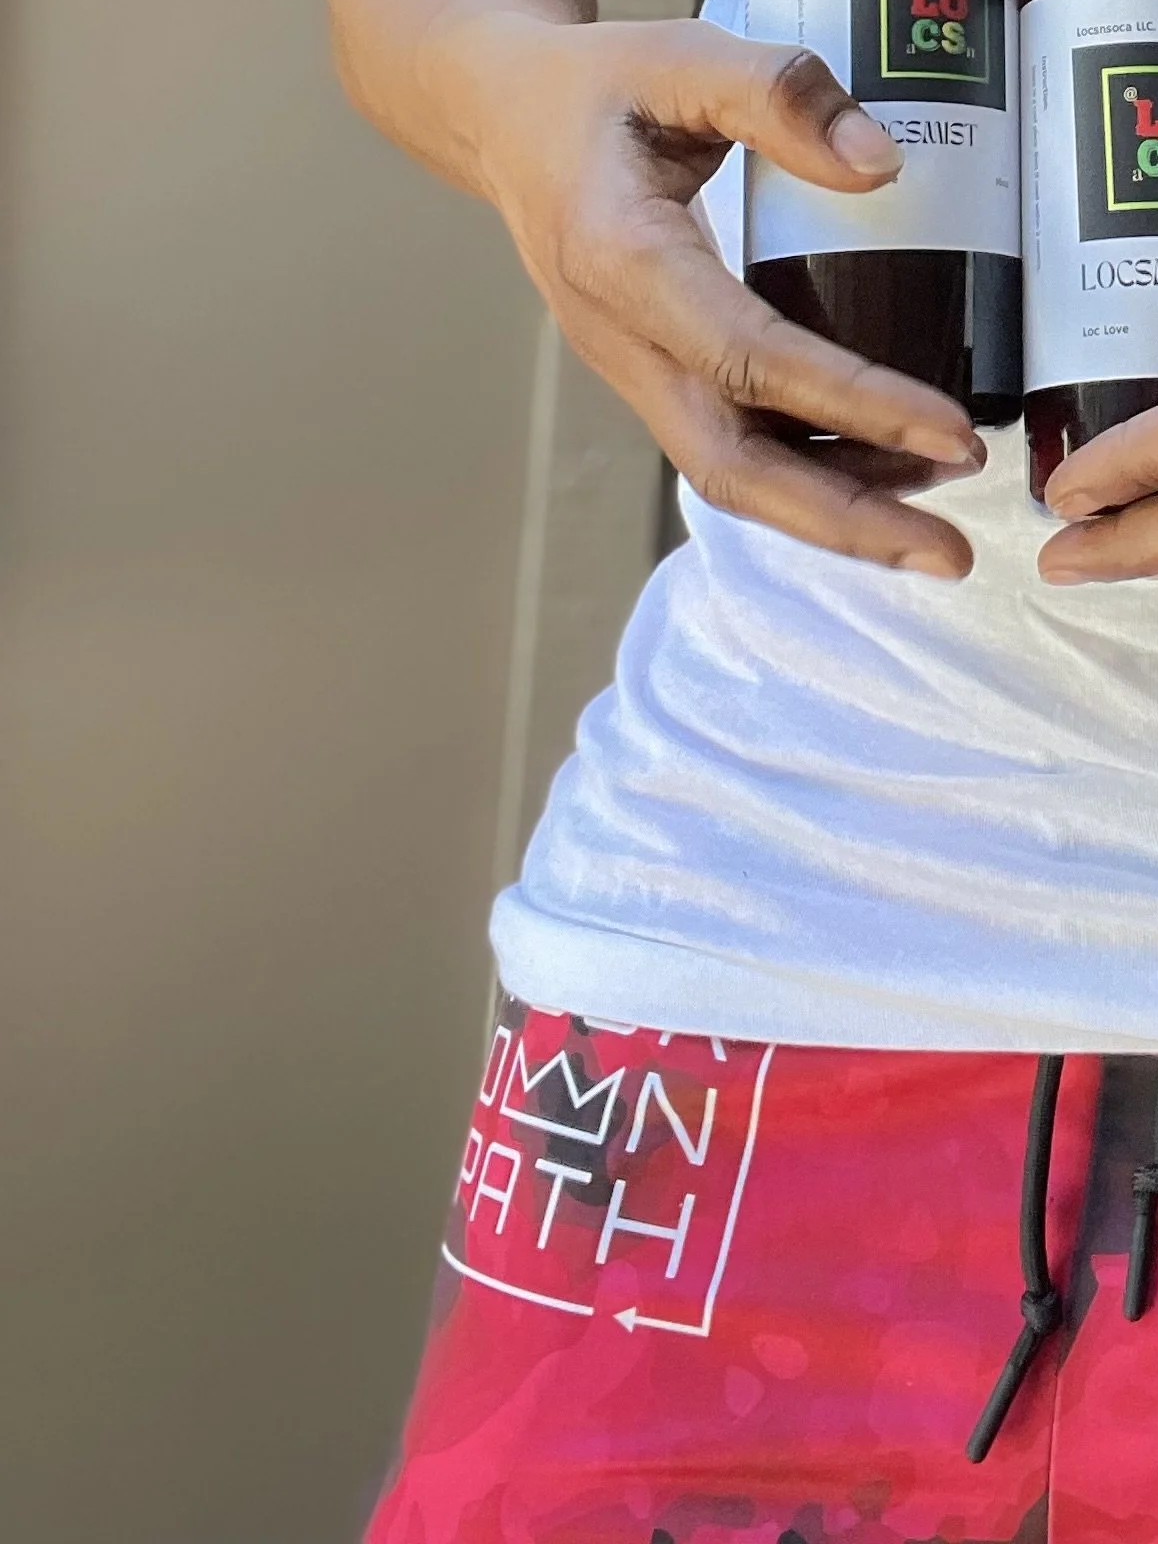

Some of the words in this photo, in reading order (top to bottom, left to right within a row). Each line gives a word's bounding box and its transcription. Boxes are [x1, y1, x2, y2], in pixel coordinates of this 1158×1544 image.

[877, 120, 978, 146] CSMIST
[1082, 326, 1100, 337] Loc
[1103, 323, 1130, 336] Love
[454, 1127, 697, 1280] PATH
